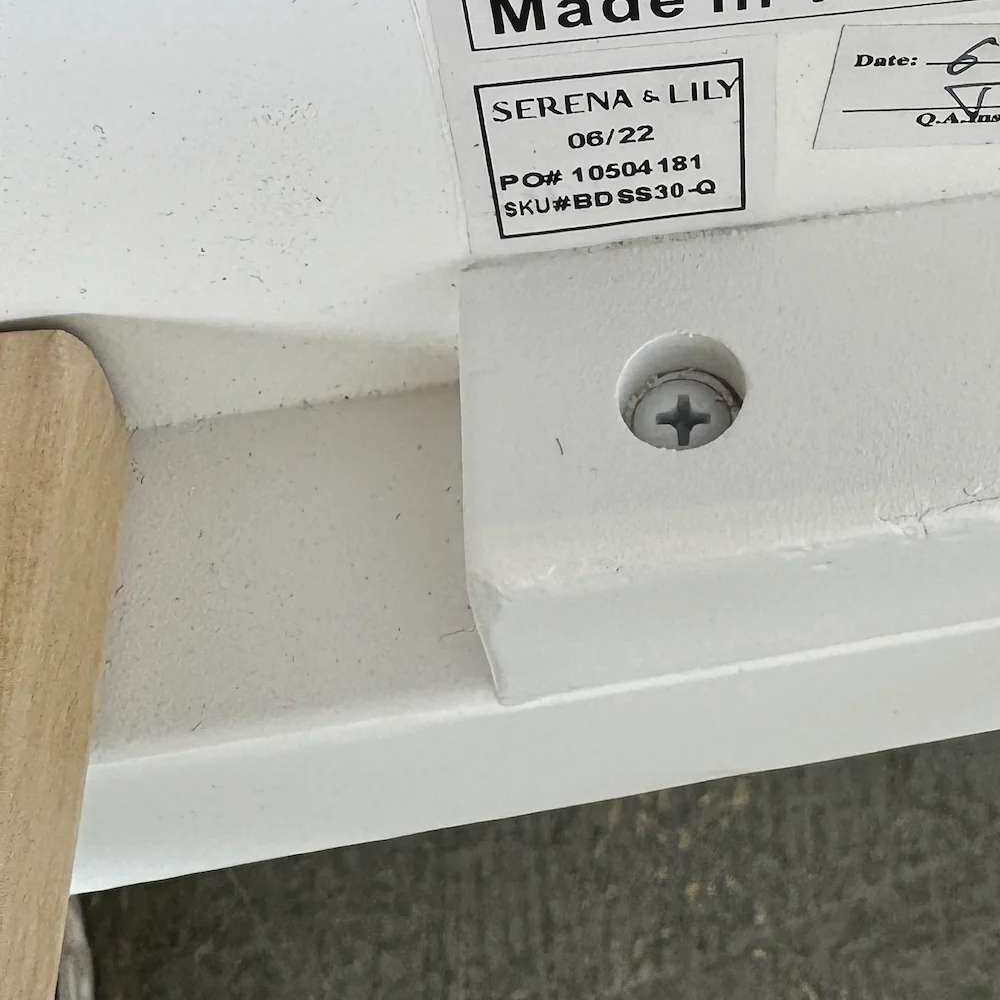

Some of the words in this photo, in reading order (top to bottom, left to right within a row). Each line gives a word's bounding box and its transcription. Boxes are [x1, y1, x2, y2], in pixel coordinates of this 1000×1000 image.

[854, 54, 918, 67] Date:
[492, 89, 634, 122] SERENA
[642, 90, 660, 104] &
[669, 76, 740, 104] LILY
[567, 125, 655, 149] 06/22
[499, 170, 563, 191] PO#
